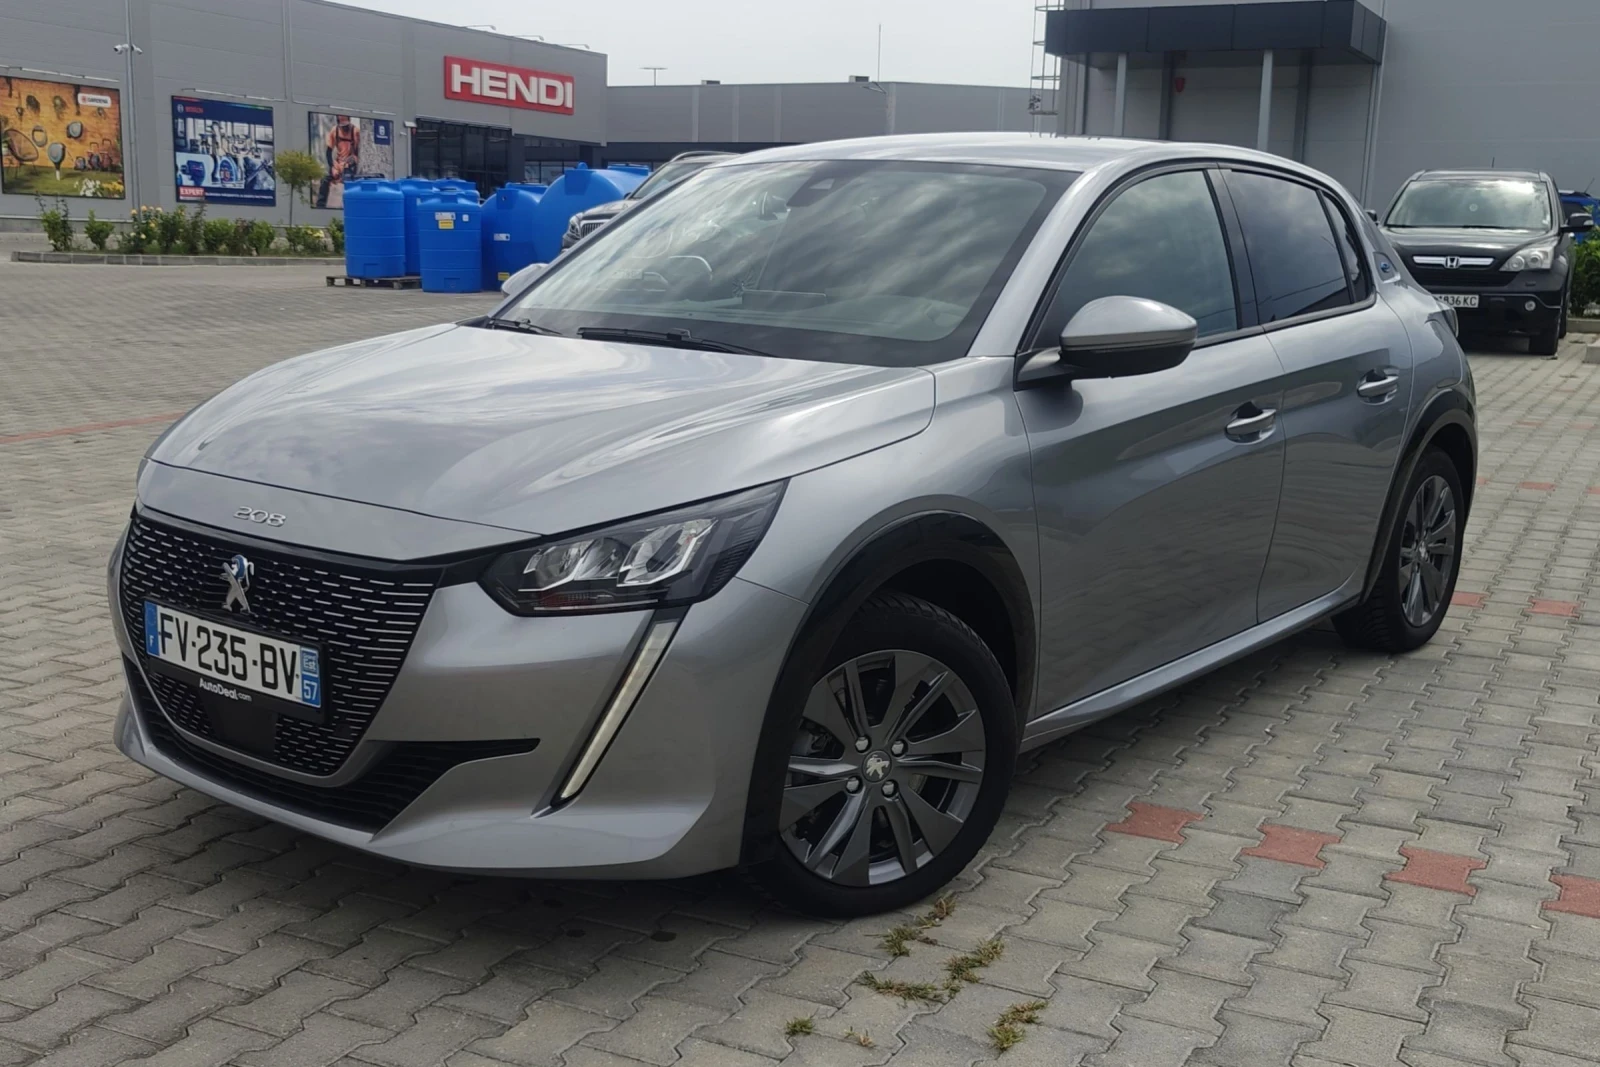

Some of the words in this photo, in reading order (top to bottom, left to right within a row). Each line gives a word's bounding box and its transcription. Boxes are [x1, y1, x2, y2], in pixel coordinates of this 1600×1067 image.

[451, 63, 573, 109] HENDI
[180, 187, 204, 196] EXPERT
[233, 506, 286, 527] 208
[149, 635, 155, 647] F
[159, 612, 297, 695] FV-235-BV
[199, 677, 252, 702] AutoDeal.com
[303, 679, 318, 701] 57
